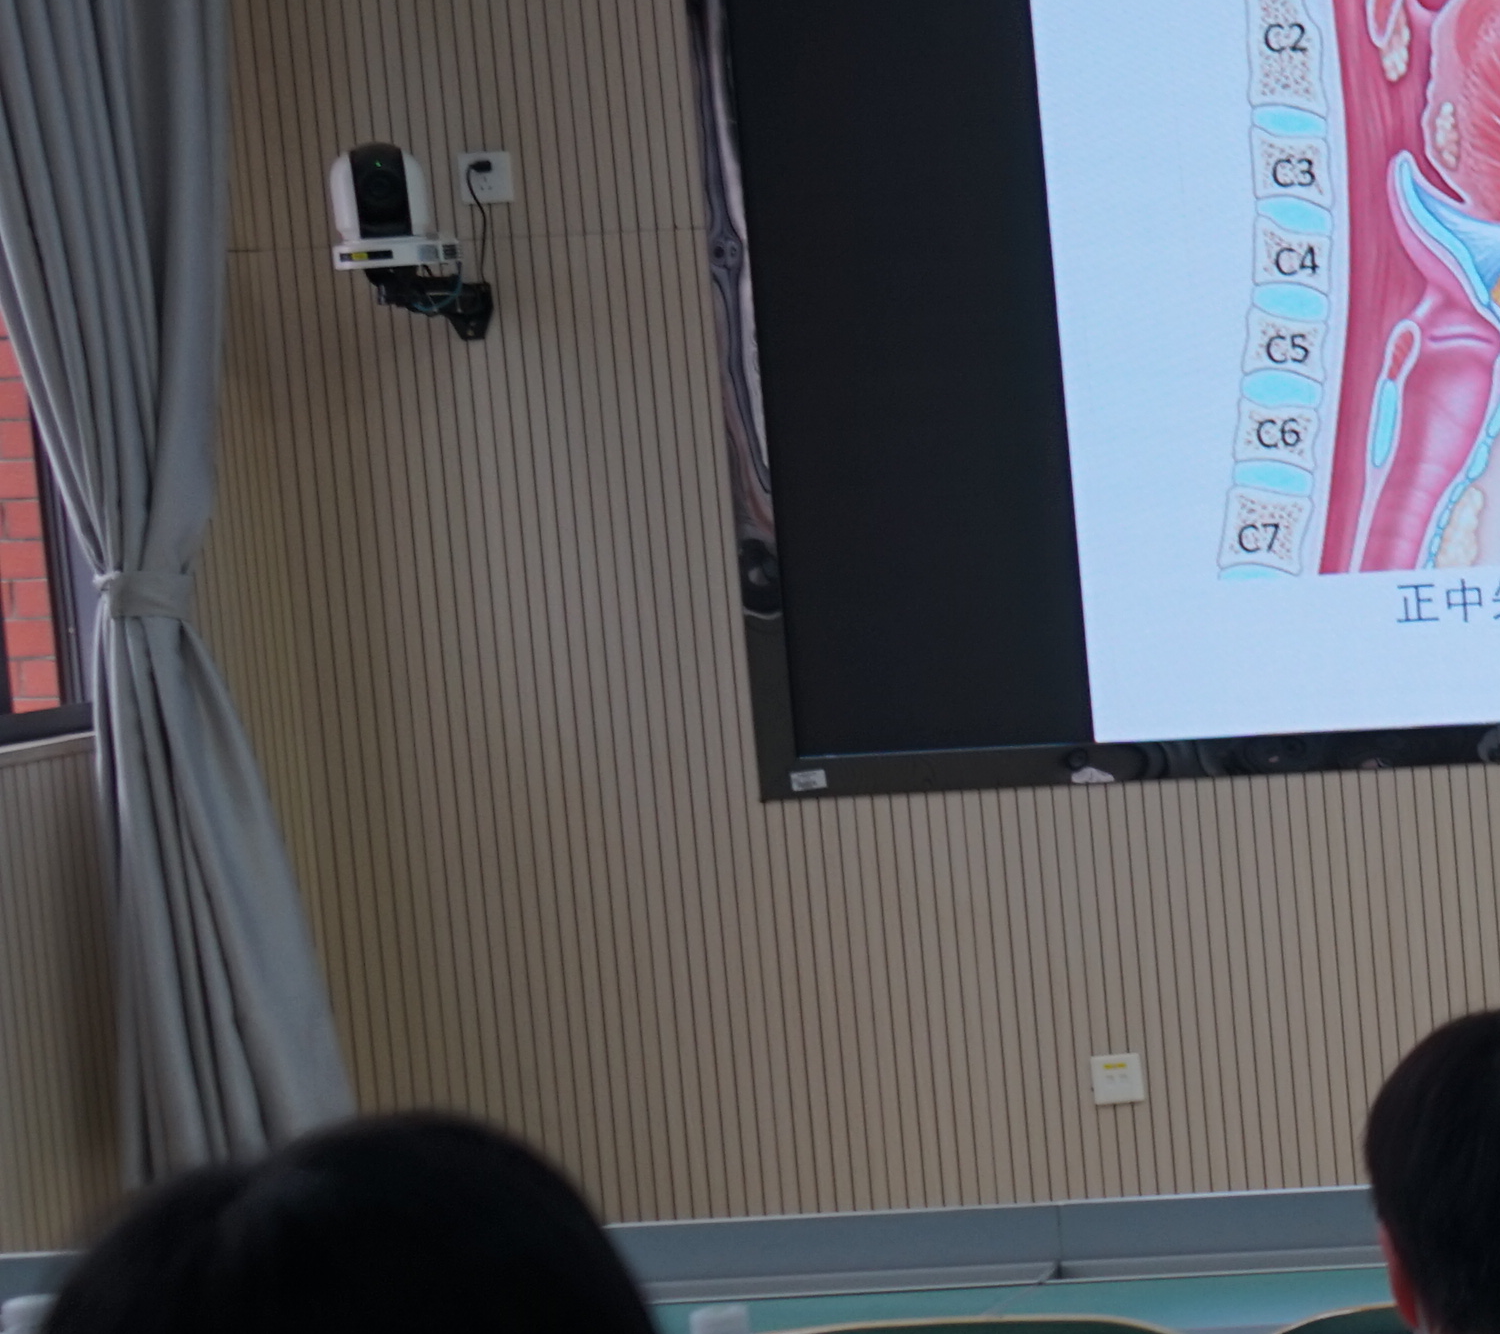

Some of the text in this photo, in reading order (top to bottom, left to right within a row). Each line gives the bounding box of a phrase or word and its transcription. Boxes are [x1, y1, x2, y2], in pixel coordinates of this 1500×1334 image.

[1264, 23, 1308, 53] C2
[1272, 157, 1317, 188] C3
[1275, 246, 1319, 277] C4
[1265, 333, 1310, 364] C5
[1256, 418, 1301, 449] C6
[1237, 523, 1281, 554] C7
